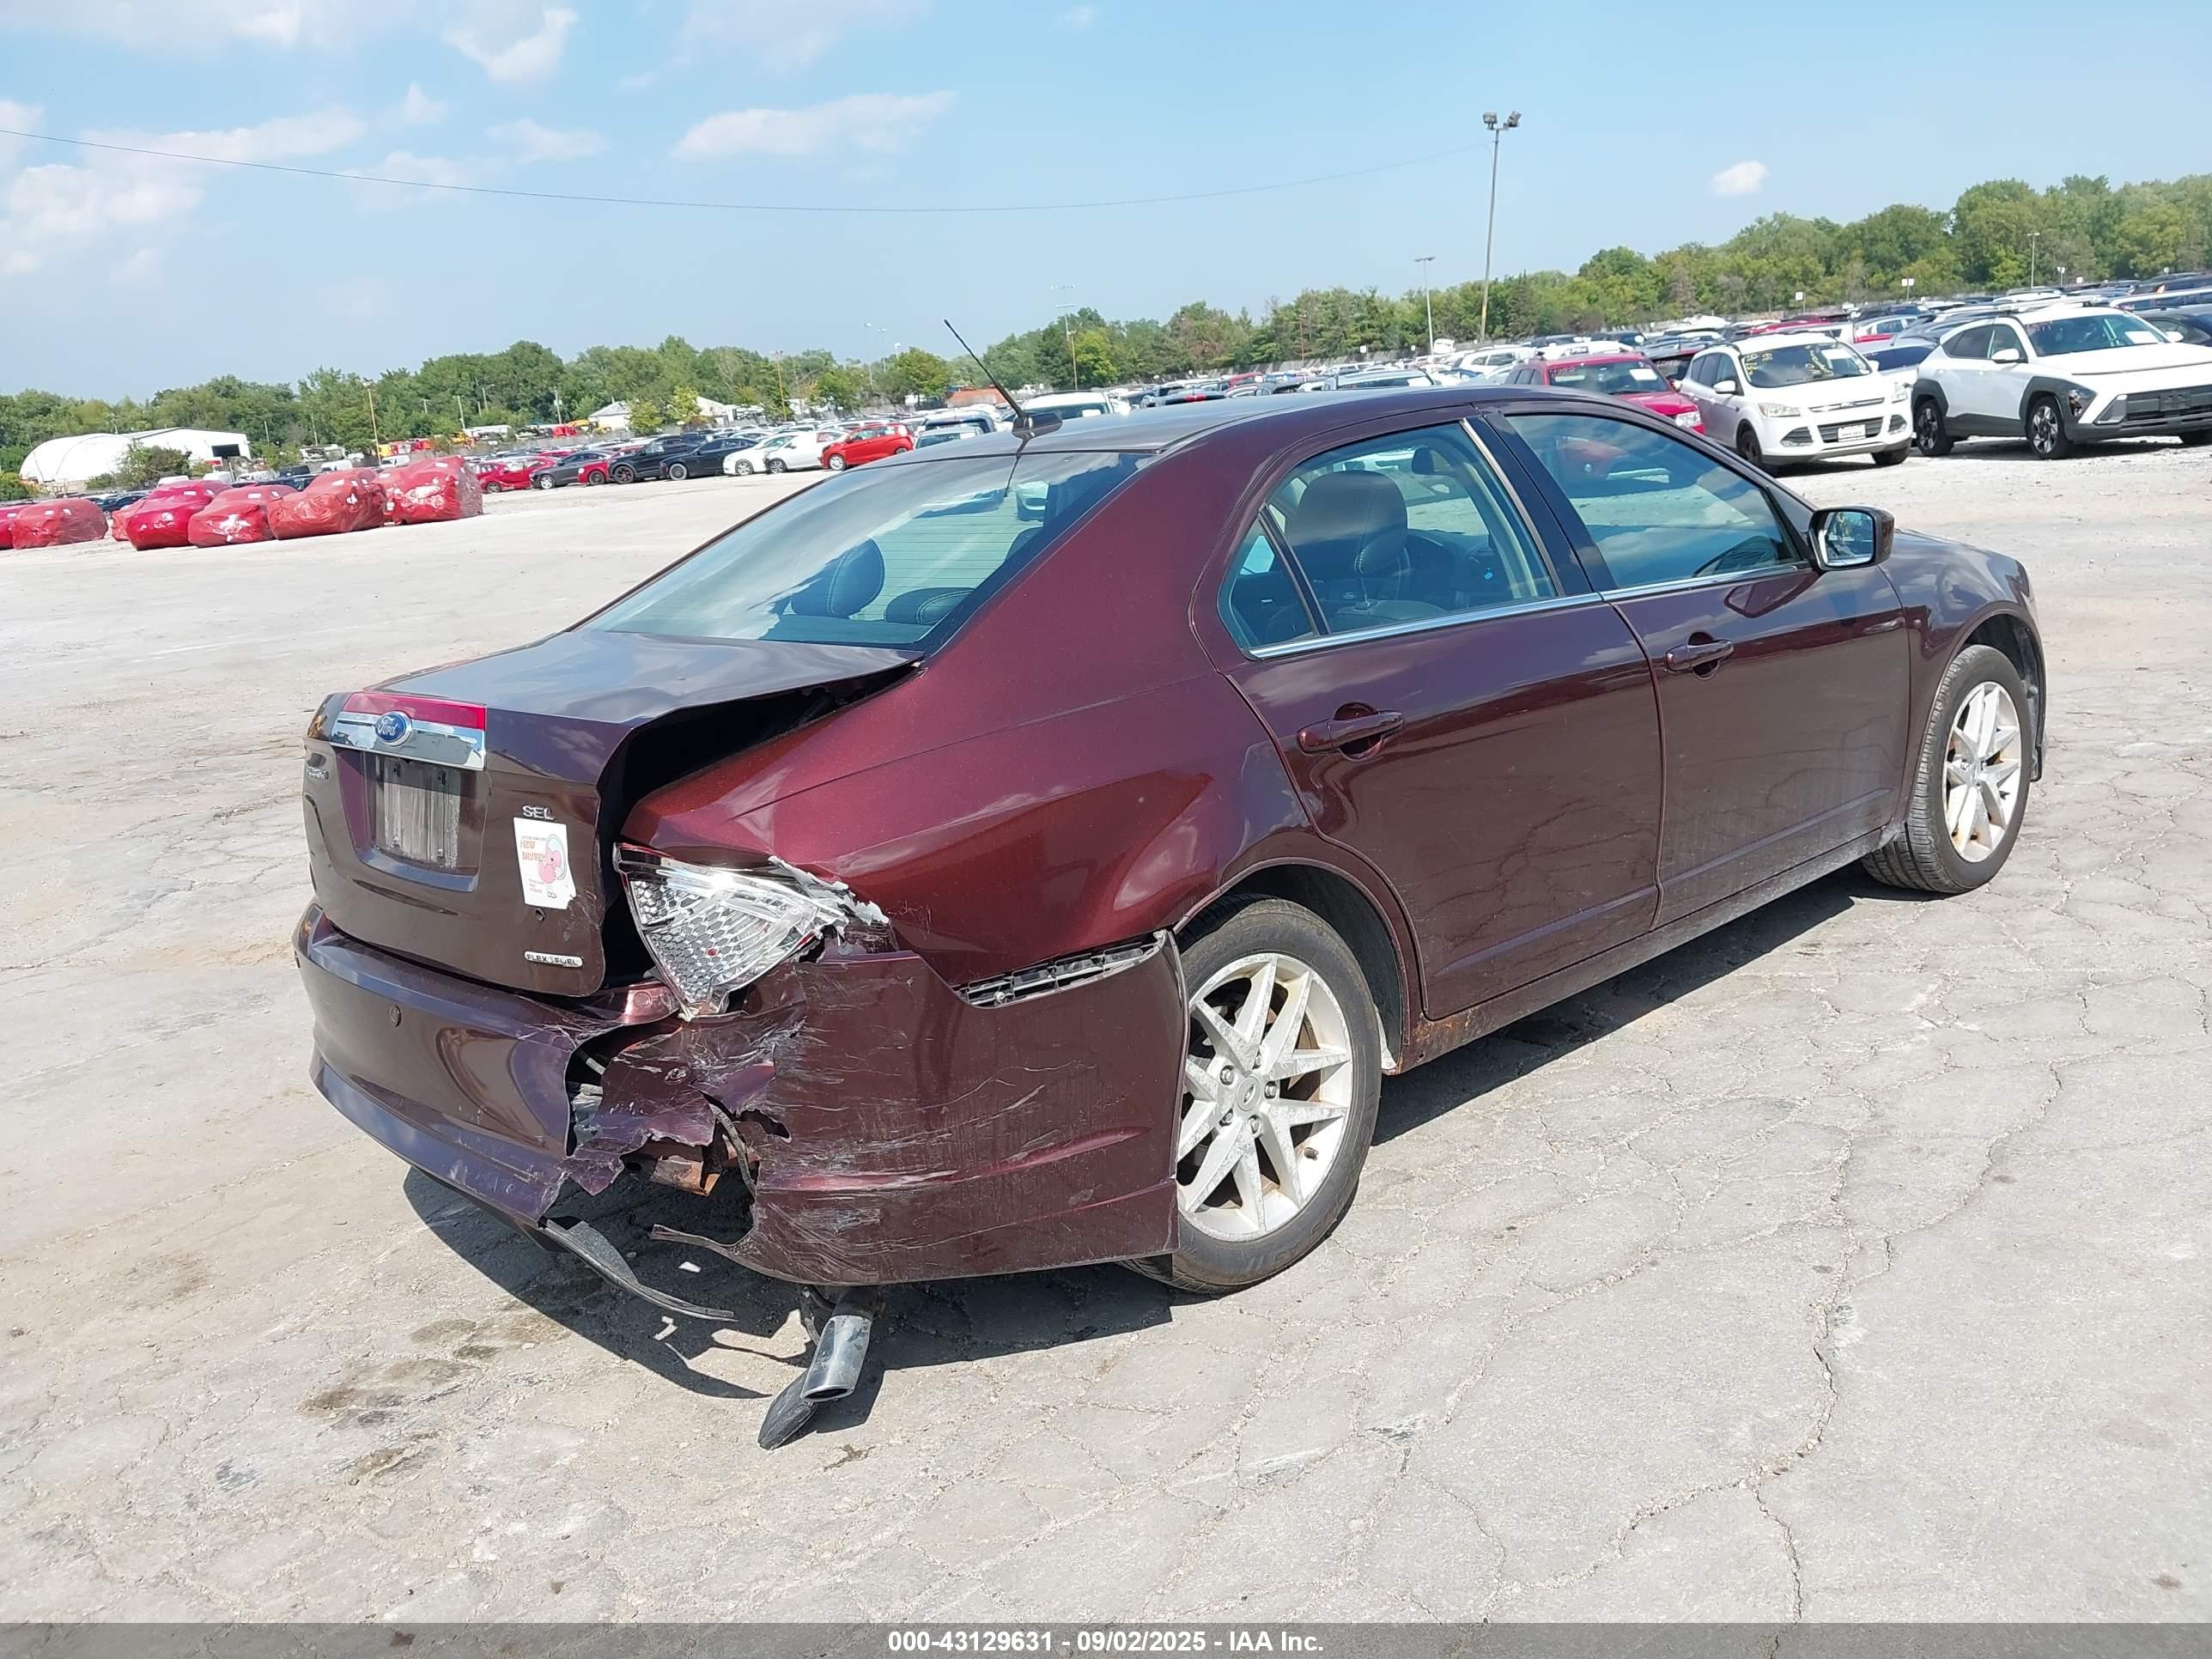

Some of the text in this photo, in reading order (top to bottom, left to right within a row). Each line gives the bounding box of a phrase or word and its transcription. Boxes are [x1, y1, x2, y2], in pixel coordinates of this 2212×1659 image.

[378, 714, 399, 737] Ford
[522, 805, 556, 821] SEL
[526, 954, 579, 966] FLEX FUEL
